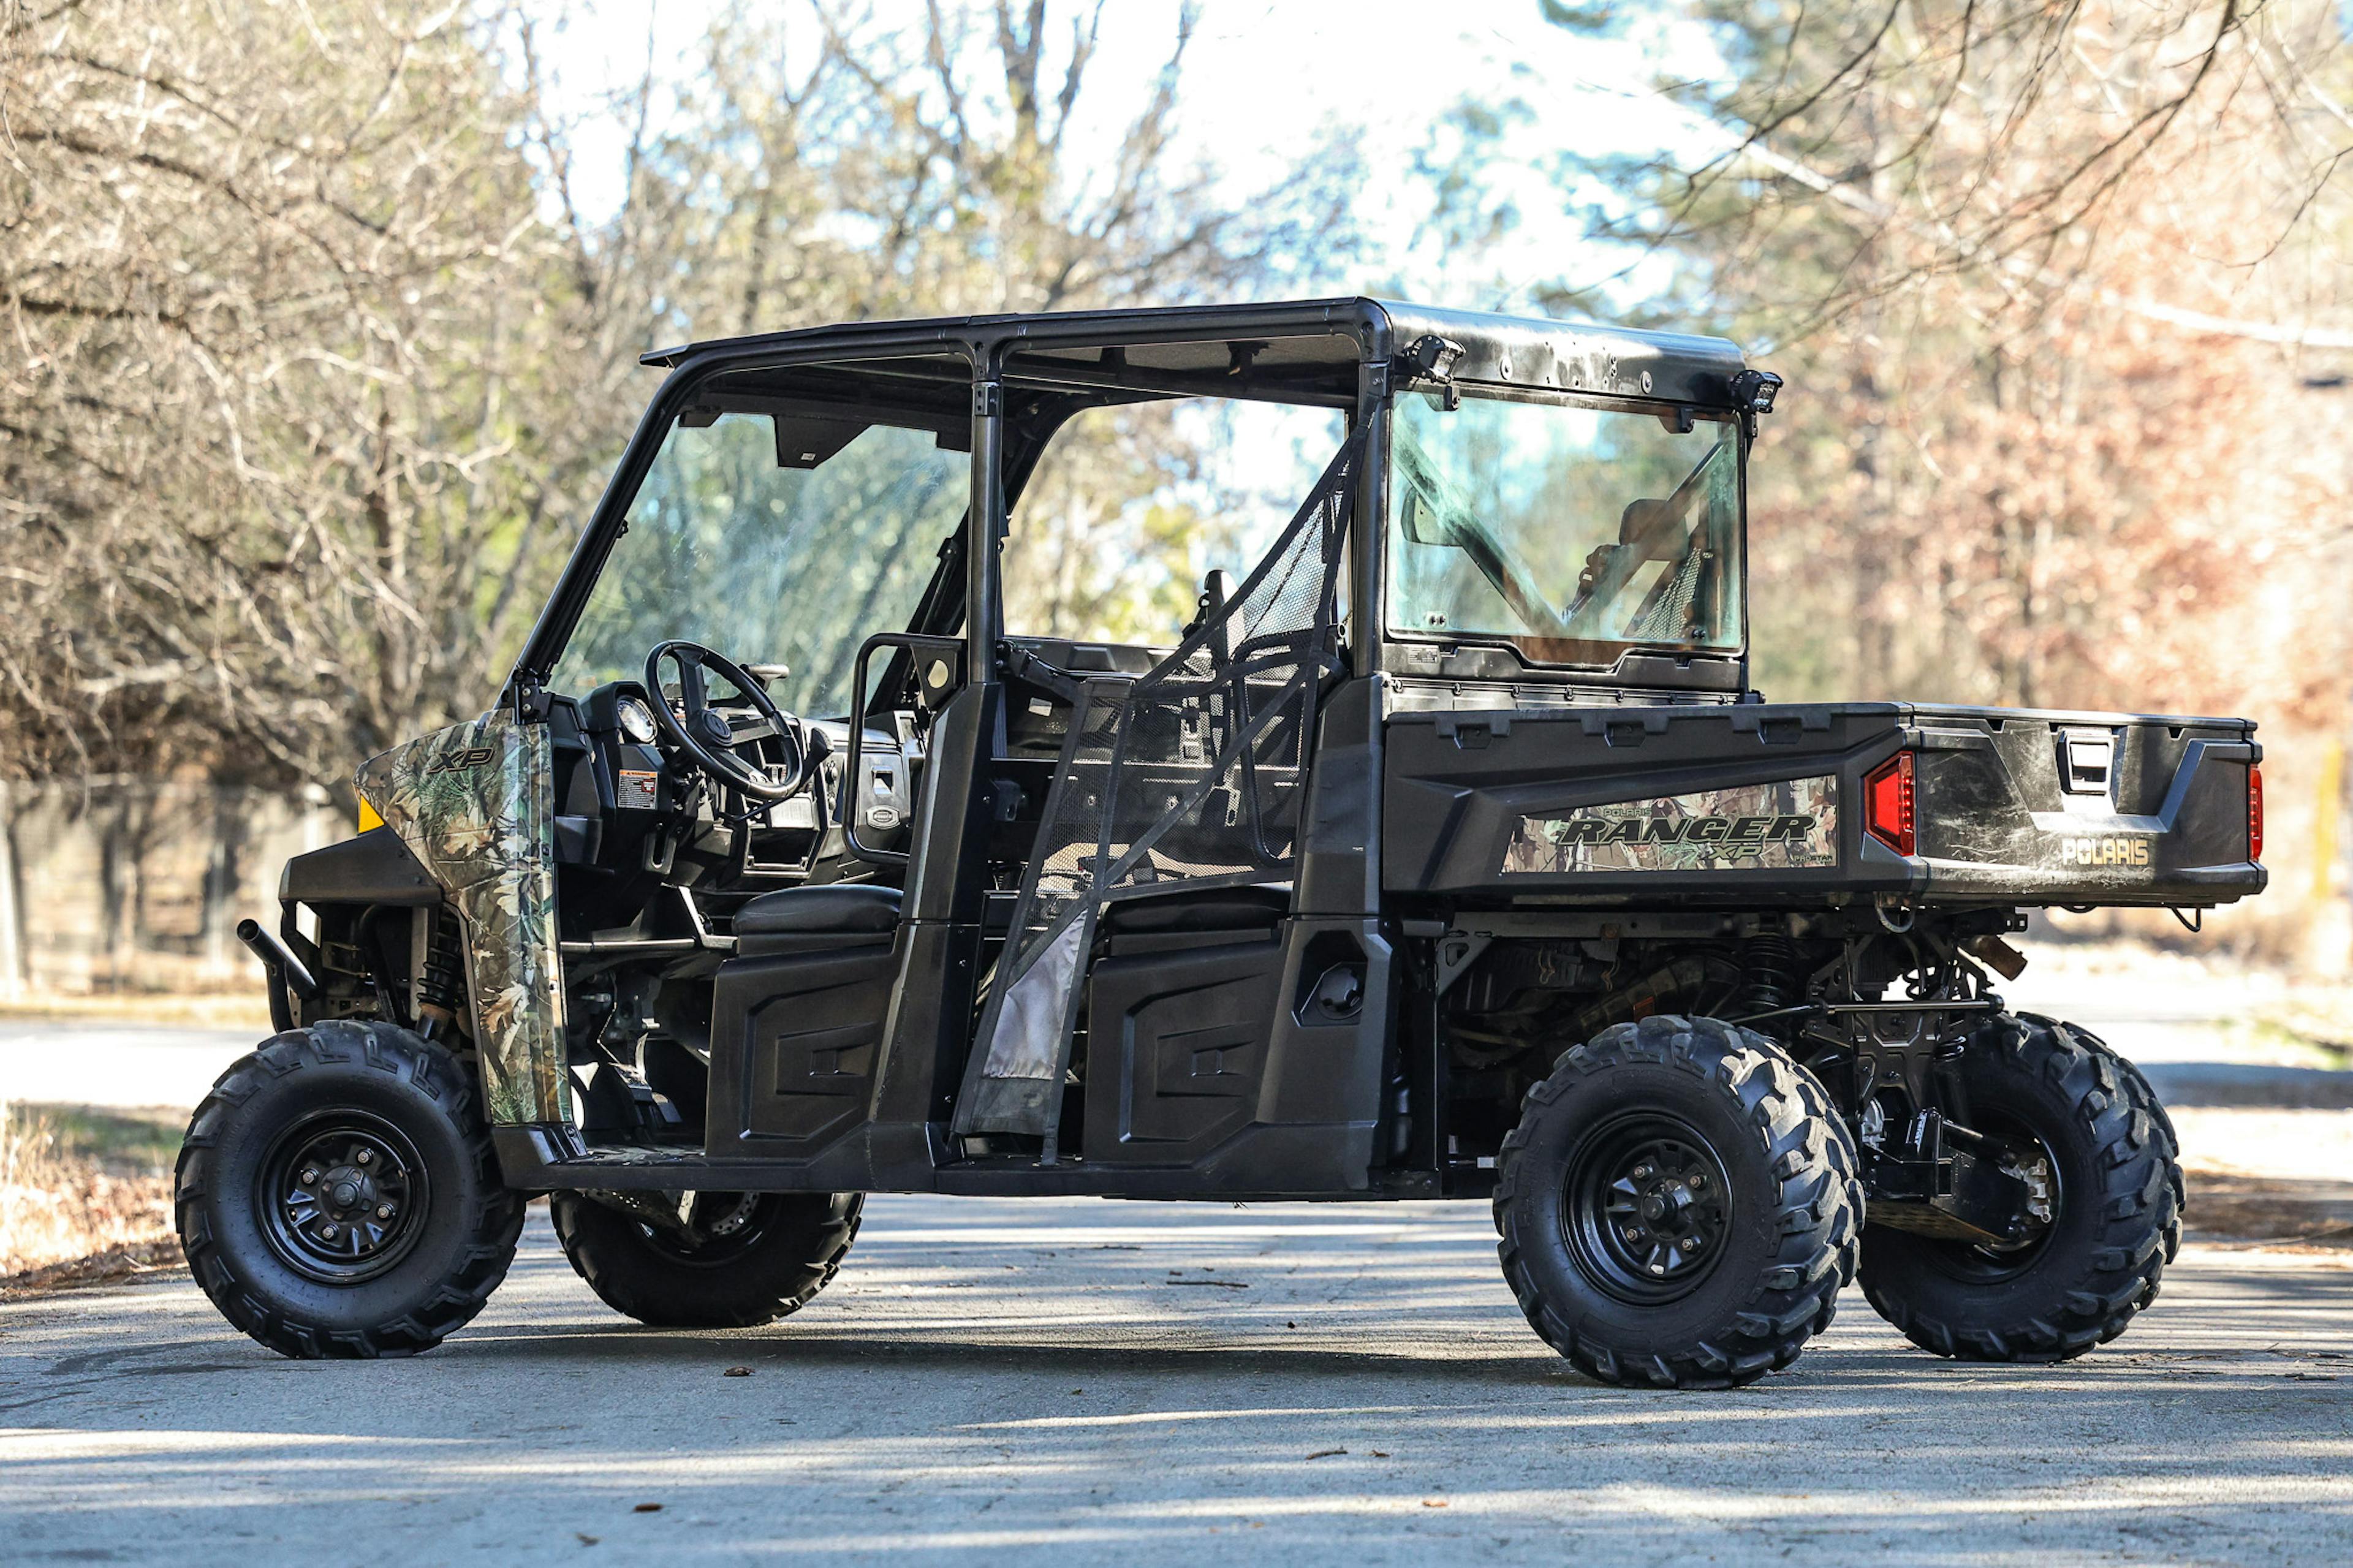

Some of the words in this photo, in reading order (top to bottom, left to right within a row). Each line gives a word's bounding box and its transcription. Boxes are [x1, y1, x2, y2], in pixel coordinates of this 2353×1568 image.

[428, 748, 494, 774] XP
[1604, 808, 1653, 817] POLARIS
[1557, 816, 1816, 845] RANGER
[1708, 844, 1762, 860] XP
[2061, 838, 2149, 865] POLARIS
